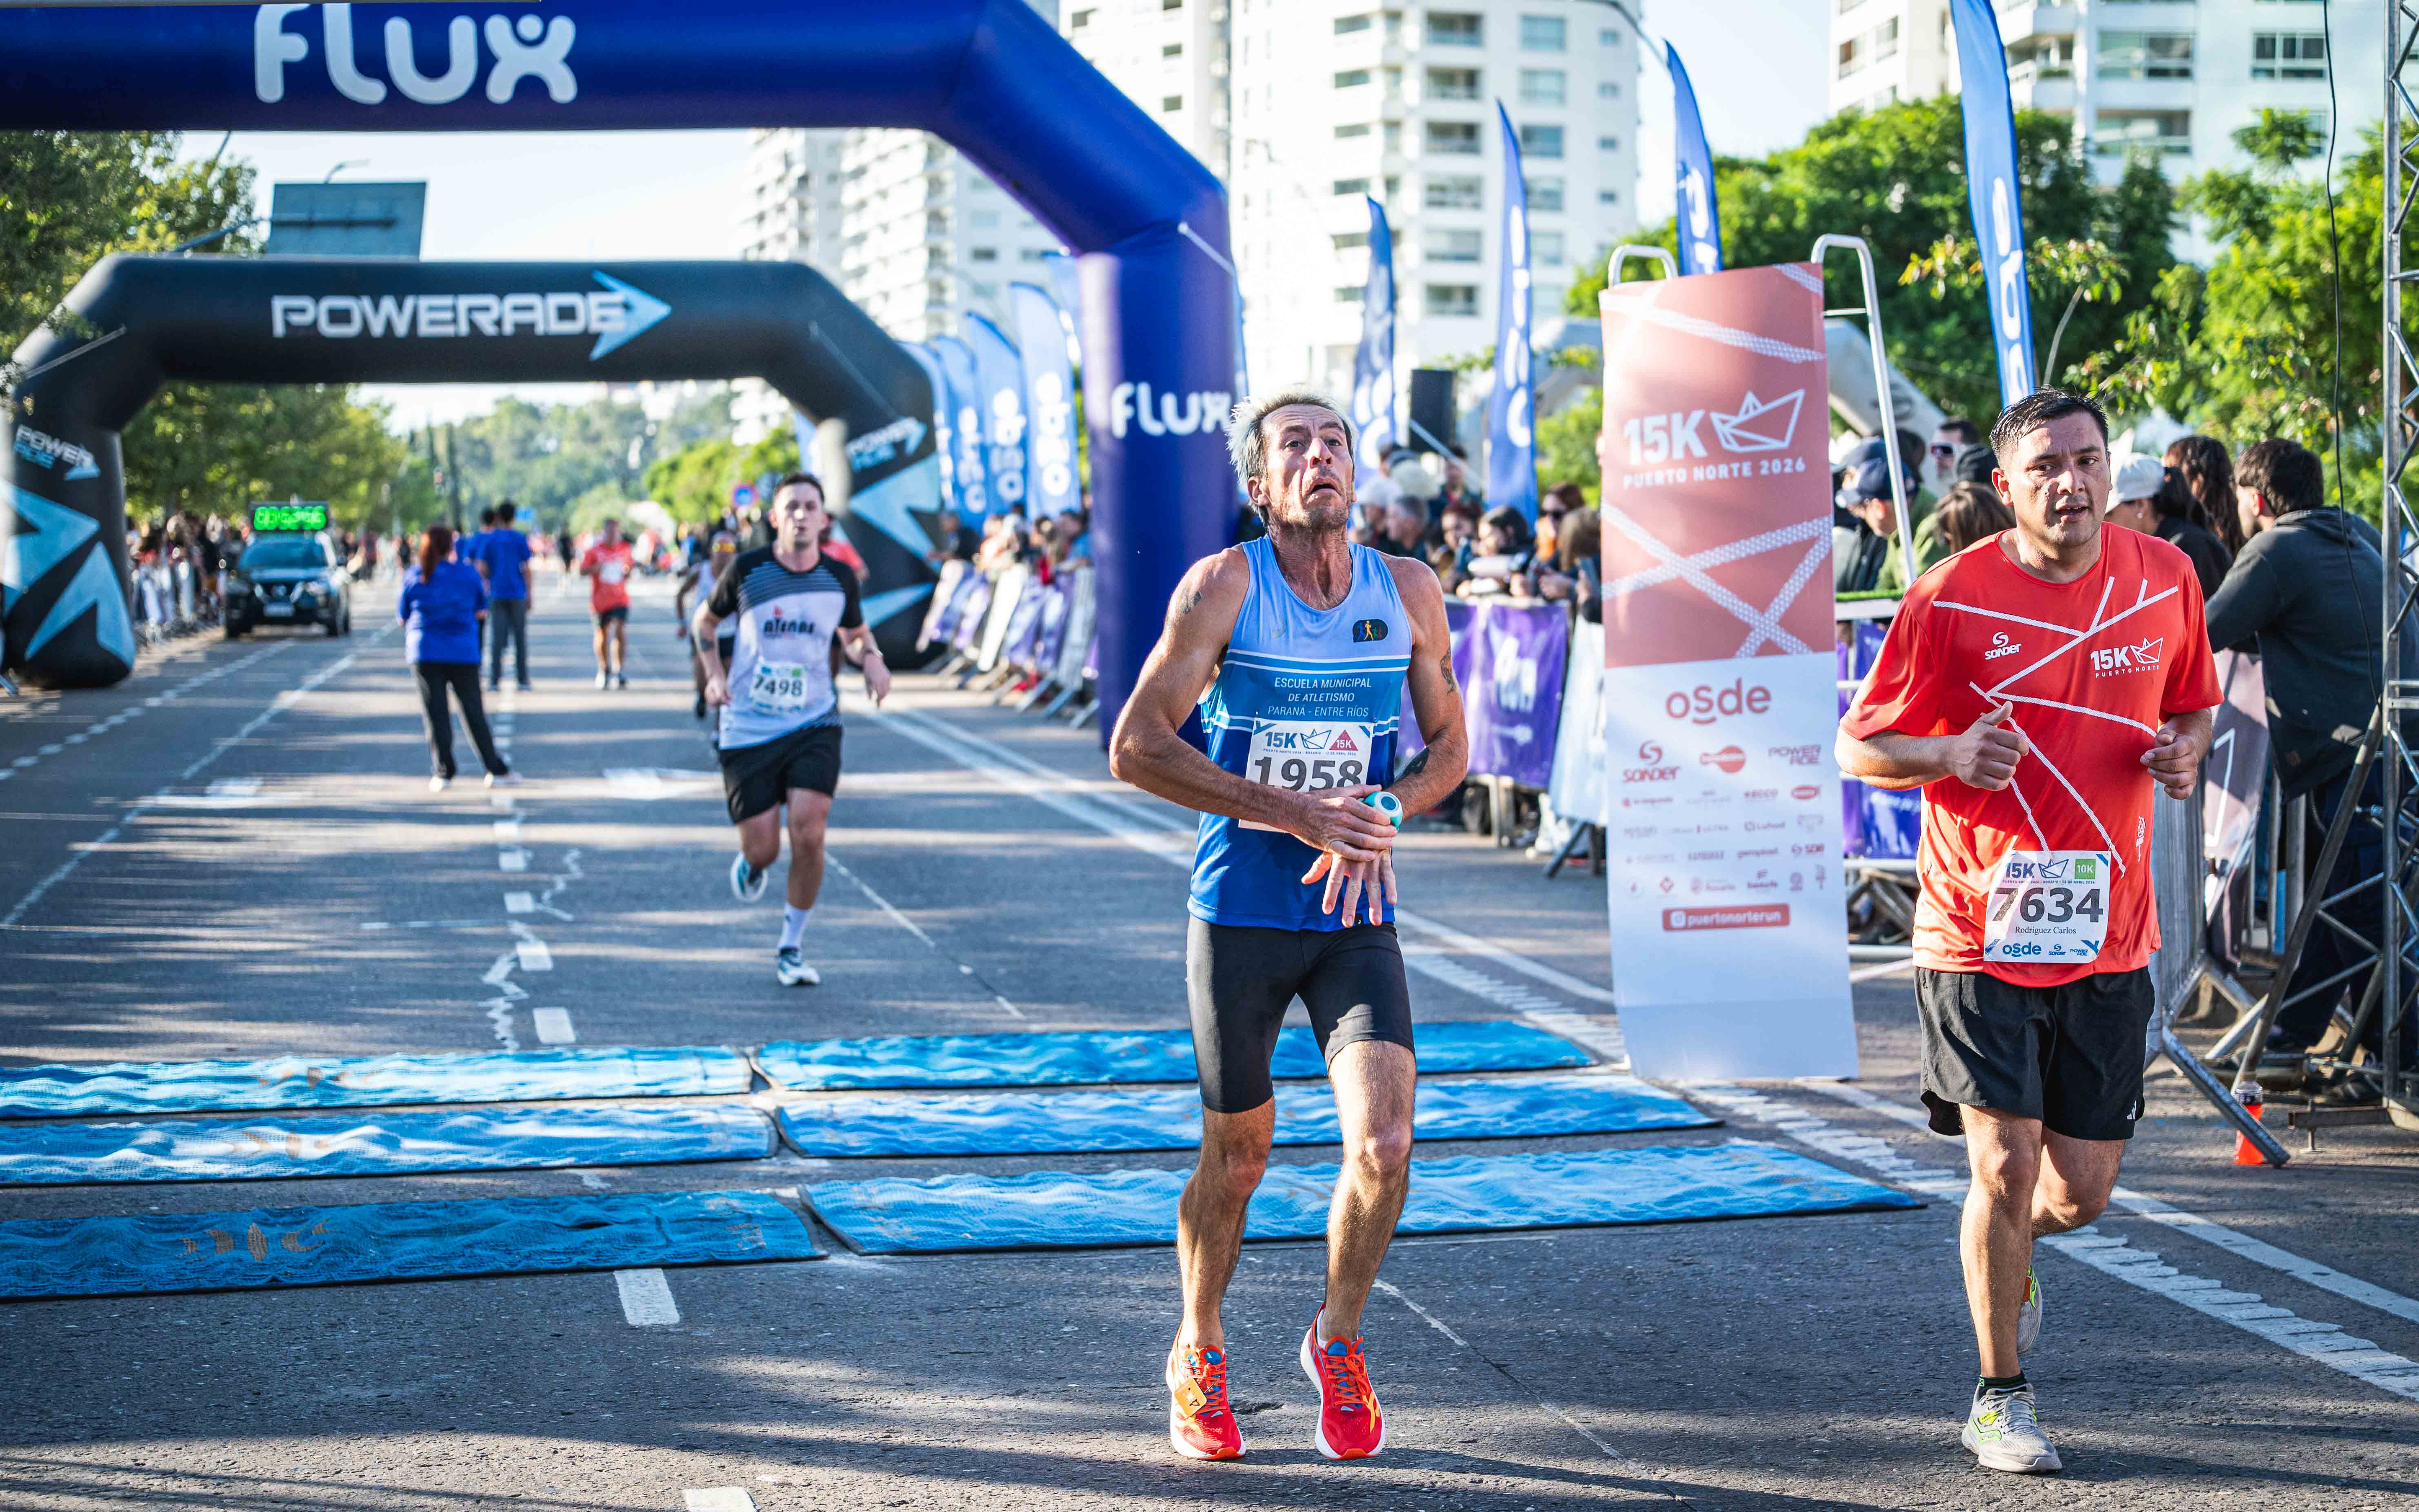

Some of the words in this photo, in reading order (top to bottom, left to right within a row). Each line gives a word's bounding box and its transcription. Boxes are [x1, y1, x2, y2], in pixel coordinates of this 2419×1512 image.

[271, 292, 624, 337] POWERADE
[1623, 409, 1707, 465] 15K
[1623, 468, 1687, 489] PUERTO
[1693, 462, 1752, 482] NORTE
[1760, 457, 1806, 475] 2026
[2090, 646, 2132, 671] 15K
[2095, 668, 2132, 678] PUERTO
[754, 674, 803, 697] 7498
[1275, 677, 1318, 688] ESCUELA
[1321, 678, 1372, 688] MUNICIPAL
[1288, 693, 1300, 702] DE
[1302, 693, 1355, 702] ATLETISMO
[1666, 677, 1771, 721] osde
[1268, 705, 1306, 715] PARANÁ
[1314, 707, 1346, 716] ENTRE
[1347, 705, 1369, 717] RÍOS
[1265, 732, 1297, 748] 15K
[1336, 740, 1353, 748] 15K
[1768, 744, 1822, 758] POWER
[1255, 757, 1363, 793] 1958
[2006, 863, 2036, 878] 15K
[2077, 865, 2093, 873] 10K
[1993, 887, 2104, 923] 7634
[2015, 926, 2051, 935] Rodriguez
[2002, 941, 2041, 957] osde
